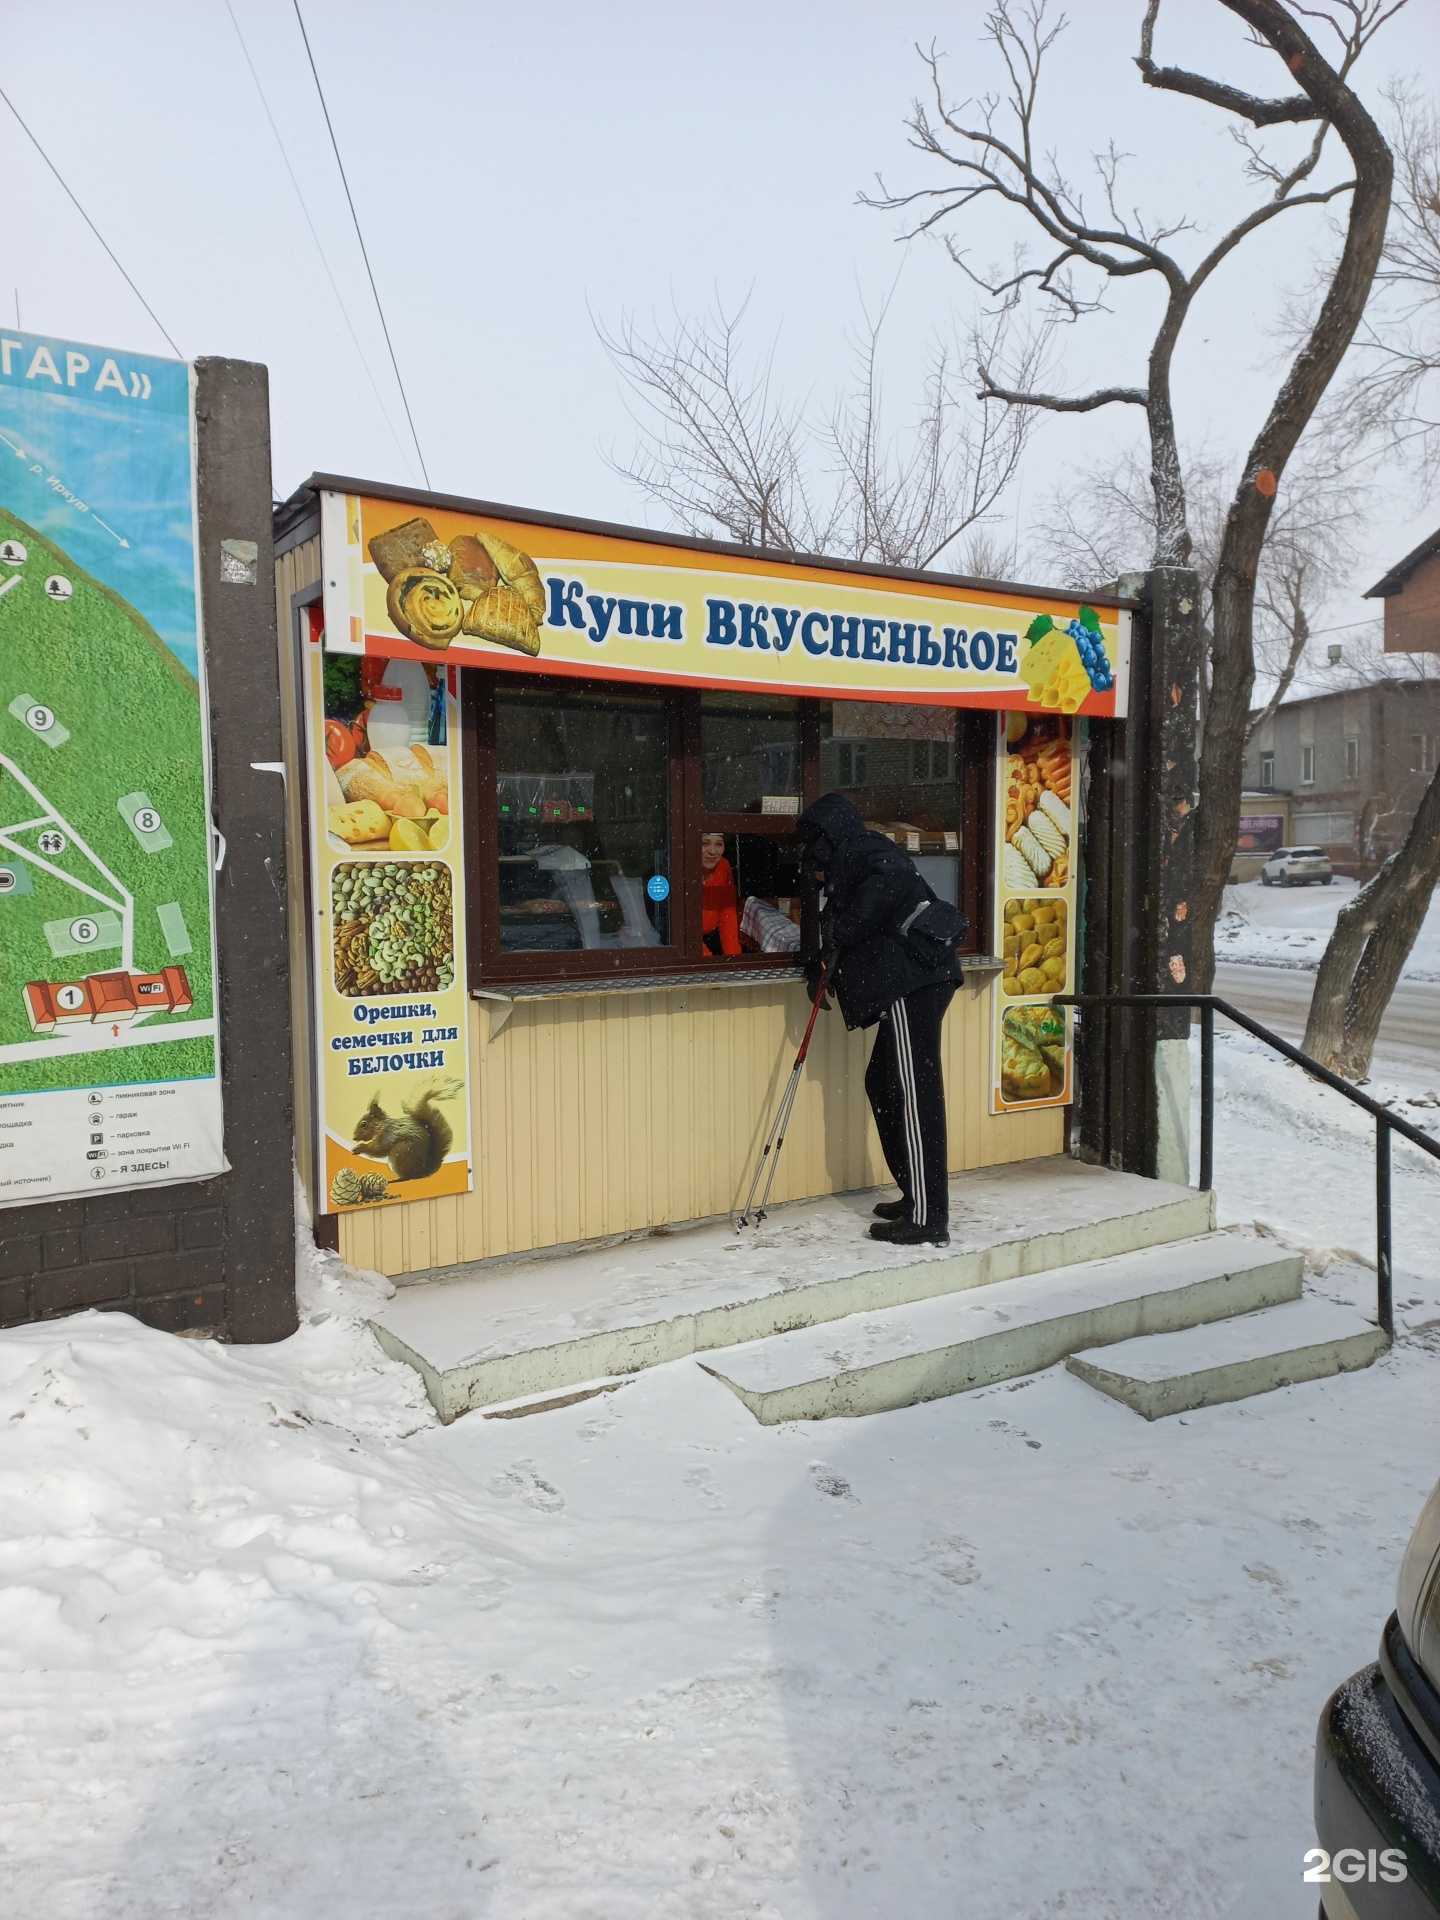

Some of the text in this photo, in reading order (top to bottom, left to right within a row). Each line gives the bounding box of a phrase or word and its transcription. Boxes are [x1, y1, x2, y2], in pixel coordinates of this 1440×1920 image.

[546, 577, 1018, 674] Купи ВКУСНЕНЬКОЕ
[34, 709, 46, 726] 9
[142, 812, 154, 828] 8
[78, 923, 91, 939] 6
[65, 989, 74, 1005] 1
[353, 1003, 437, 1024] Орешки,
[331, 1027, 458, 1050] семечки для
[347, 1050, 444, 1076] БЕЛОЧКИ
[120, 1161, 170, 1174] Я ЗДЕСЬ!
